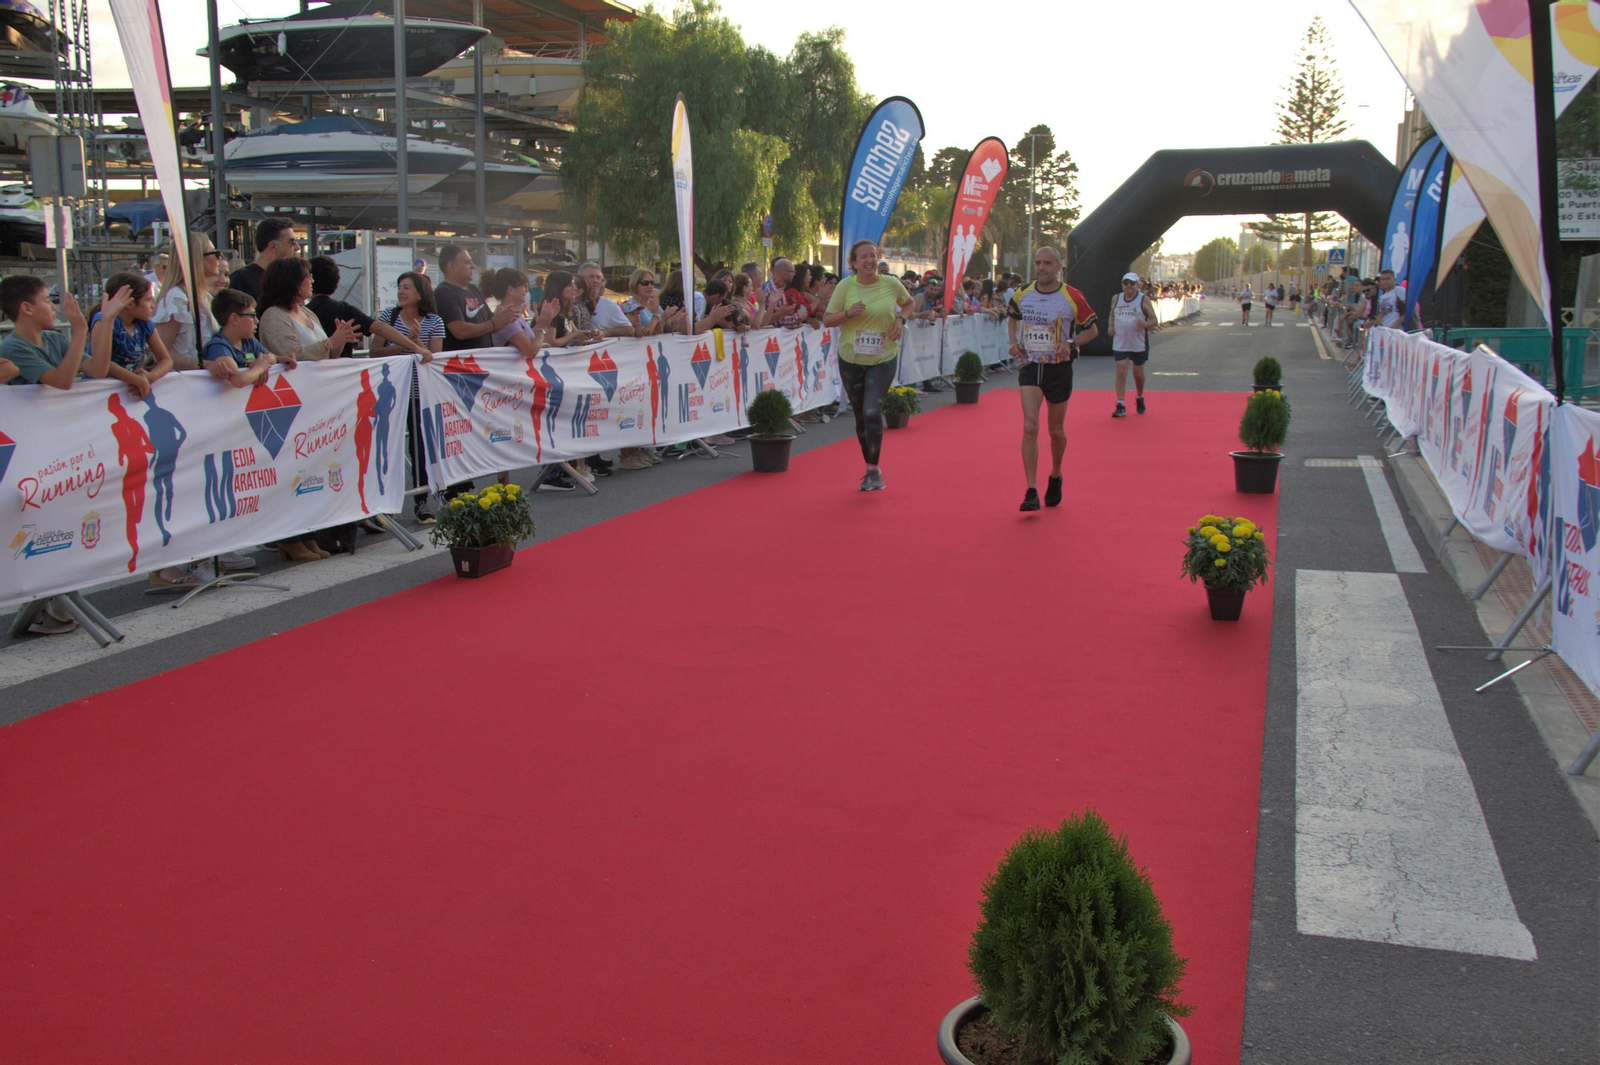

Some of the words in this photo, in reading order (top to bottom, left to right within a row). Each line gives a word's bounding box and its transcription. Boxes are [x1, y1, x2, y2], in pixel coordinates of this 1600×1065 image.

[881, 136, 919, 217] centrohogarsanchez.es
[860, 336, 881, 345] 1137
[1028, 332, 1049, 341] 1141
[70, 453, 84, 471] por
[87, 443, 96, 460] el
[294, 423, 347, 460] Running
[17, 461, 106, 512] Running
